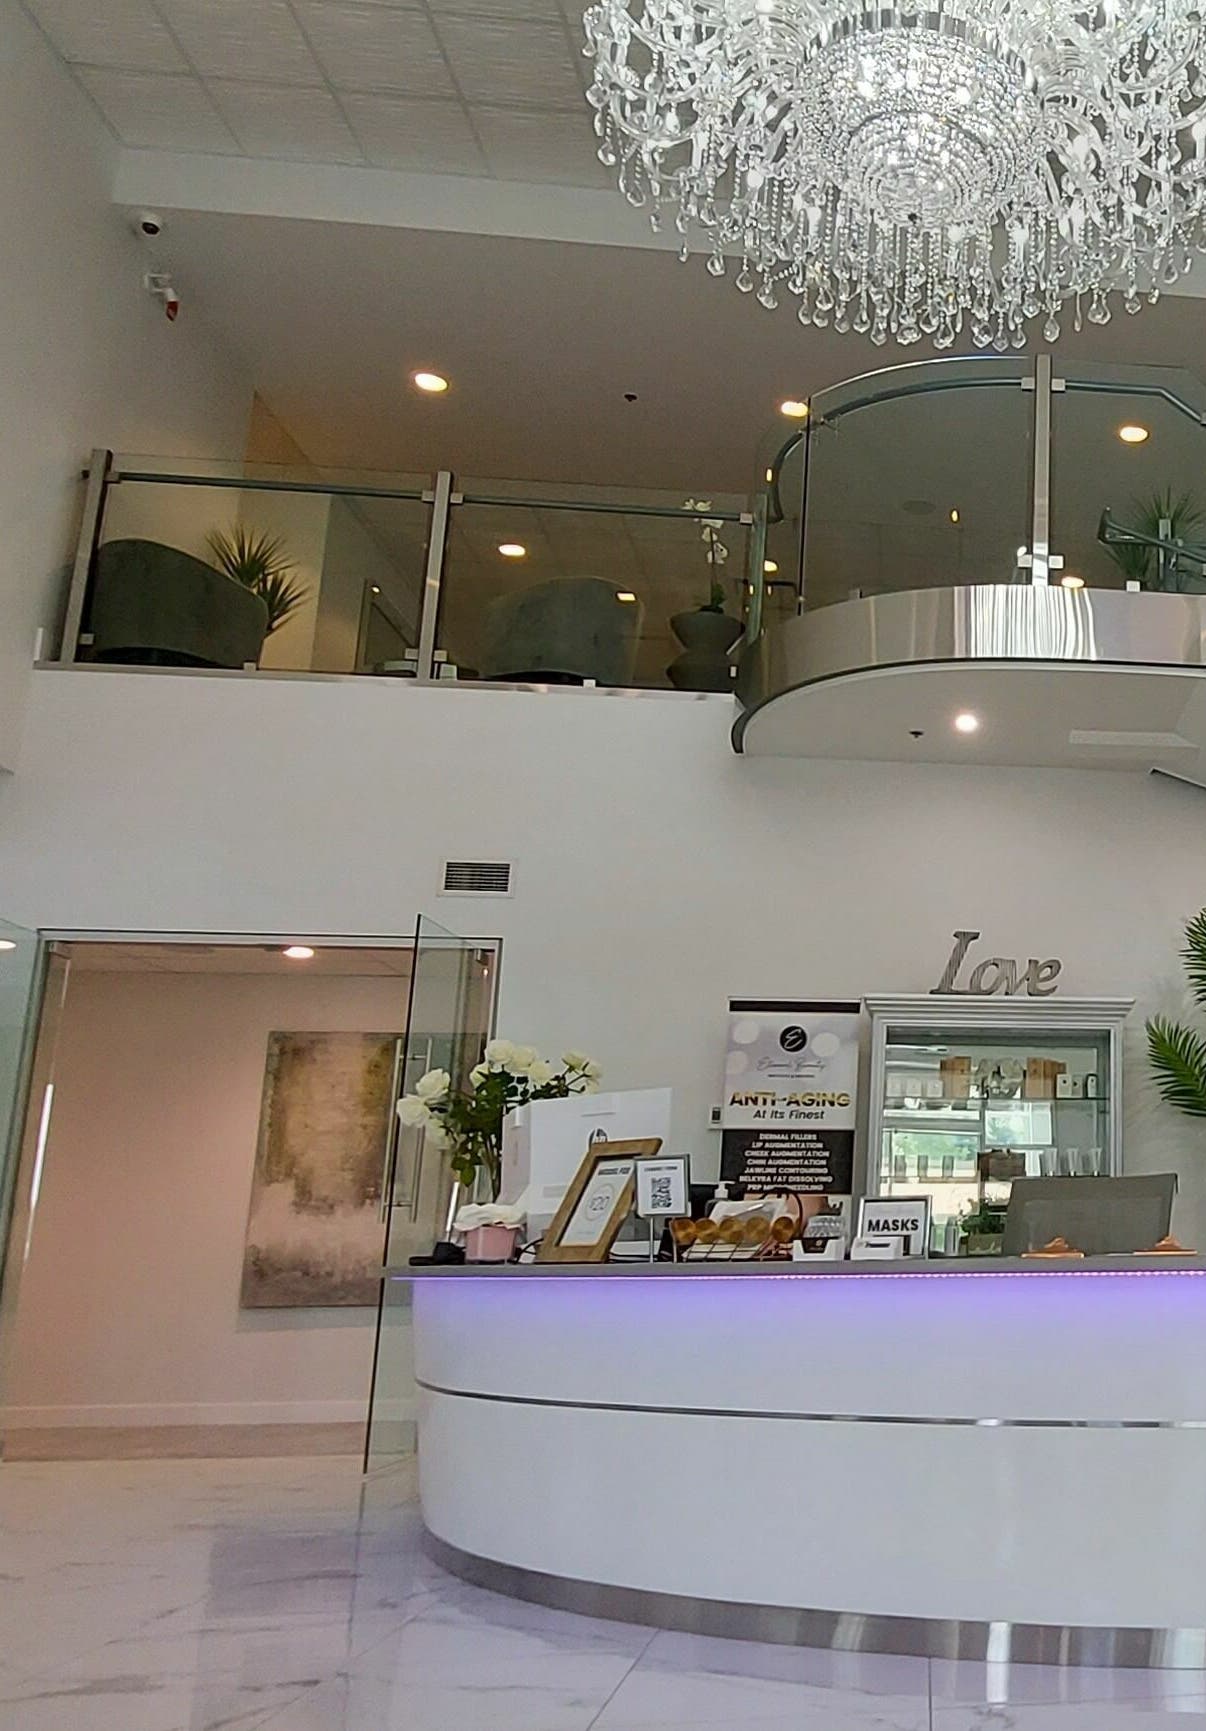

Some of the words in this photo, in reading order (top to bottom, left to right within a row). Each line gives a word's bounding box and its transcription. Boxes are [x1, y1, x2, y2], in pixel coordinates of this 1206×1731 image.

[929, 930, 1062, 996] Love
[729, 1091, 850, 1107] ANTI-AGING
[789, 1109, 825, 1119] Finest
[790, 1133, 818, 1141] FILLERS
[788, 1175, 833, 1183] DISSOLVING
[867, 1218, 919, 1232] MASKS
